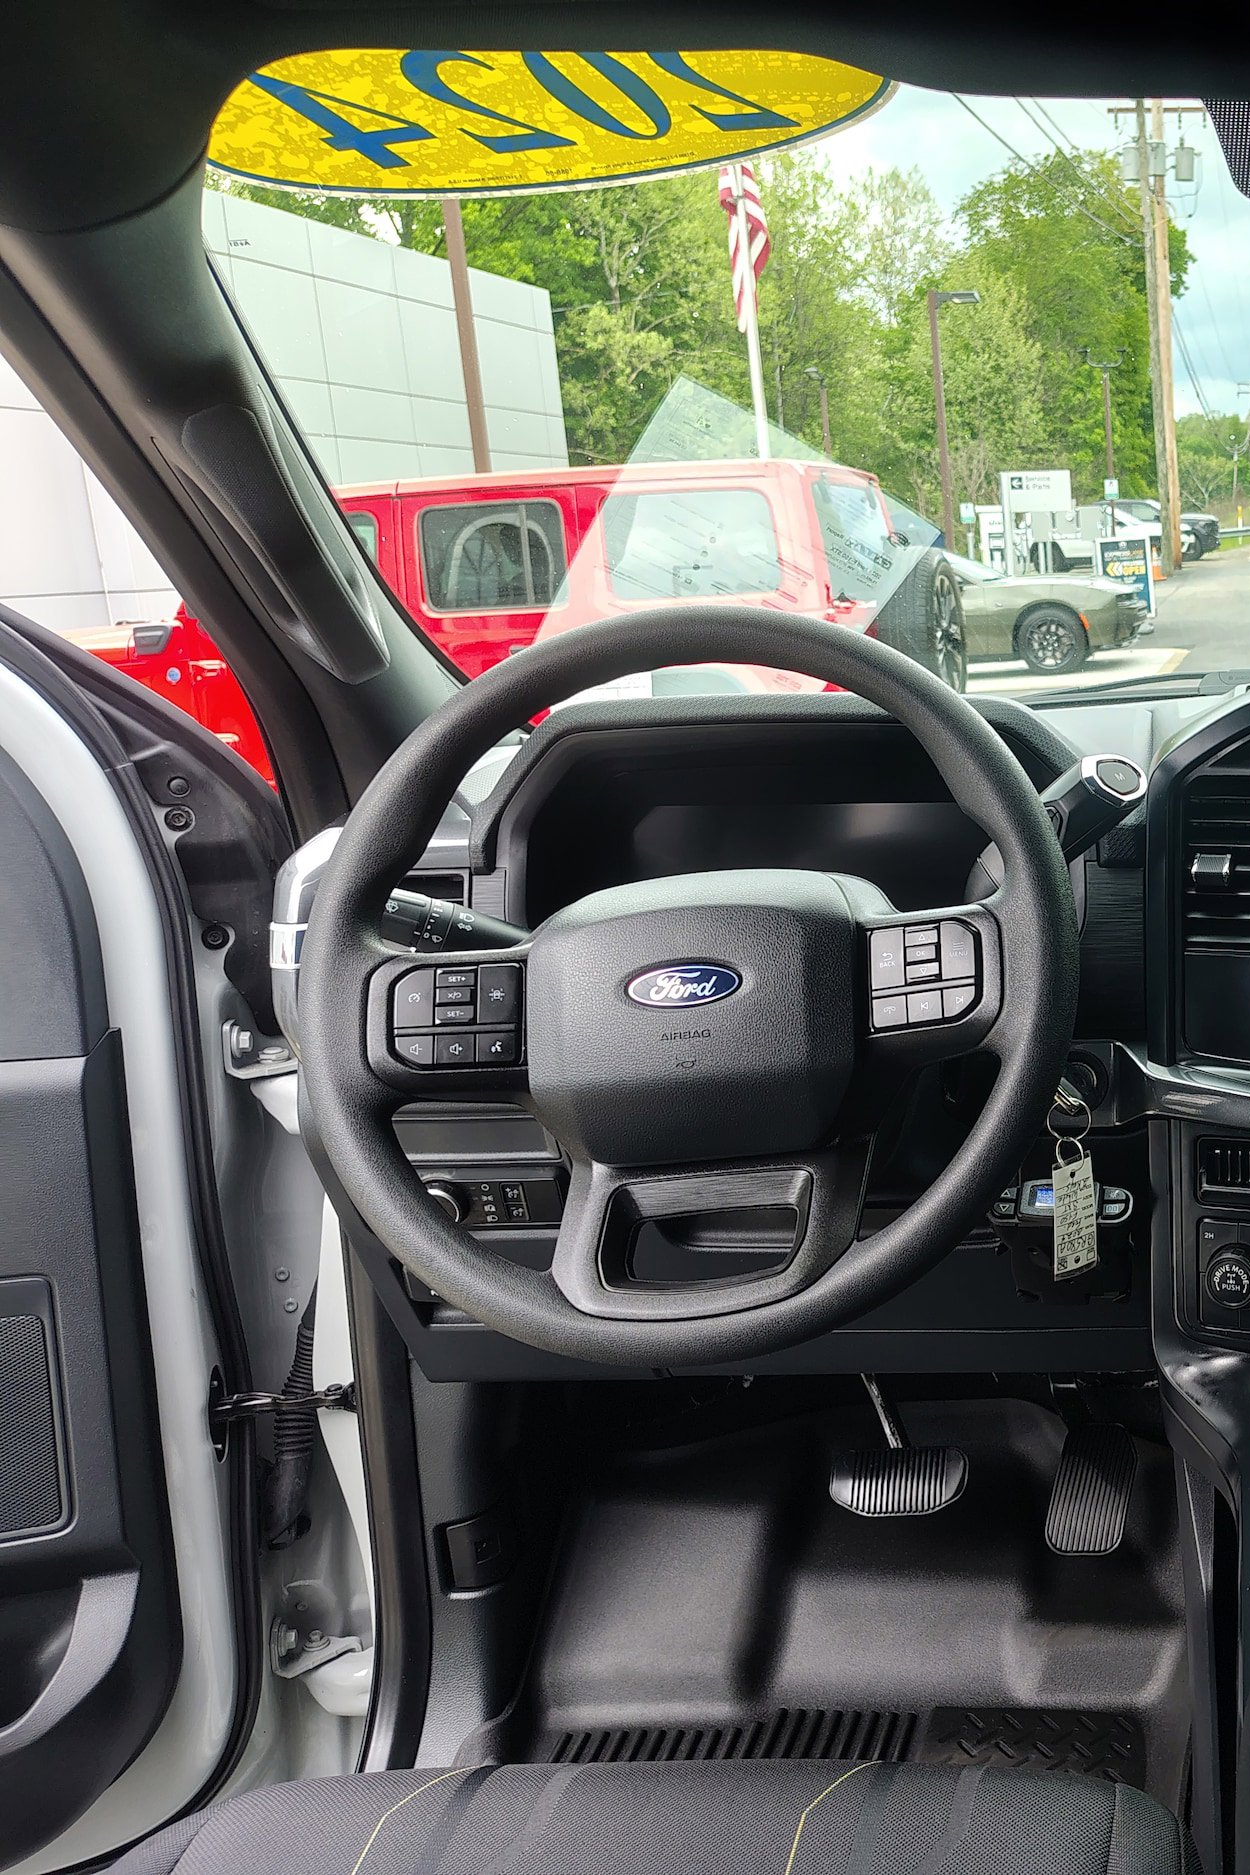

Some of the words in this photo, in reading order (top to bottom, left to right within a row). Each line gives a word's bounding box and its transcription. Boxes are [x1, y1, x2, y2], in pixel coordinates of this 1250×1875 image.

[650, 971, 717, 1000] Ford
[660, 1029, 711, 1041] AIRBAG
[1214, 1264, 1230, 1282] DRIVE
[1232, 1264, 1250, 1284] MODE
